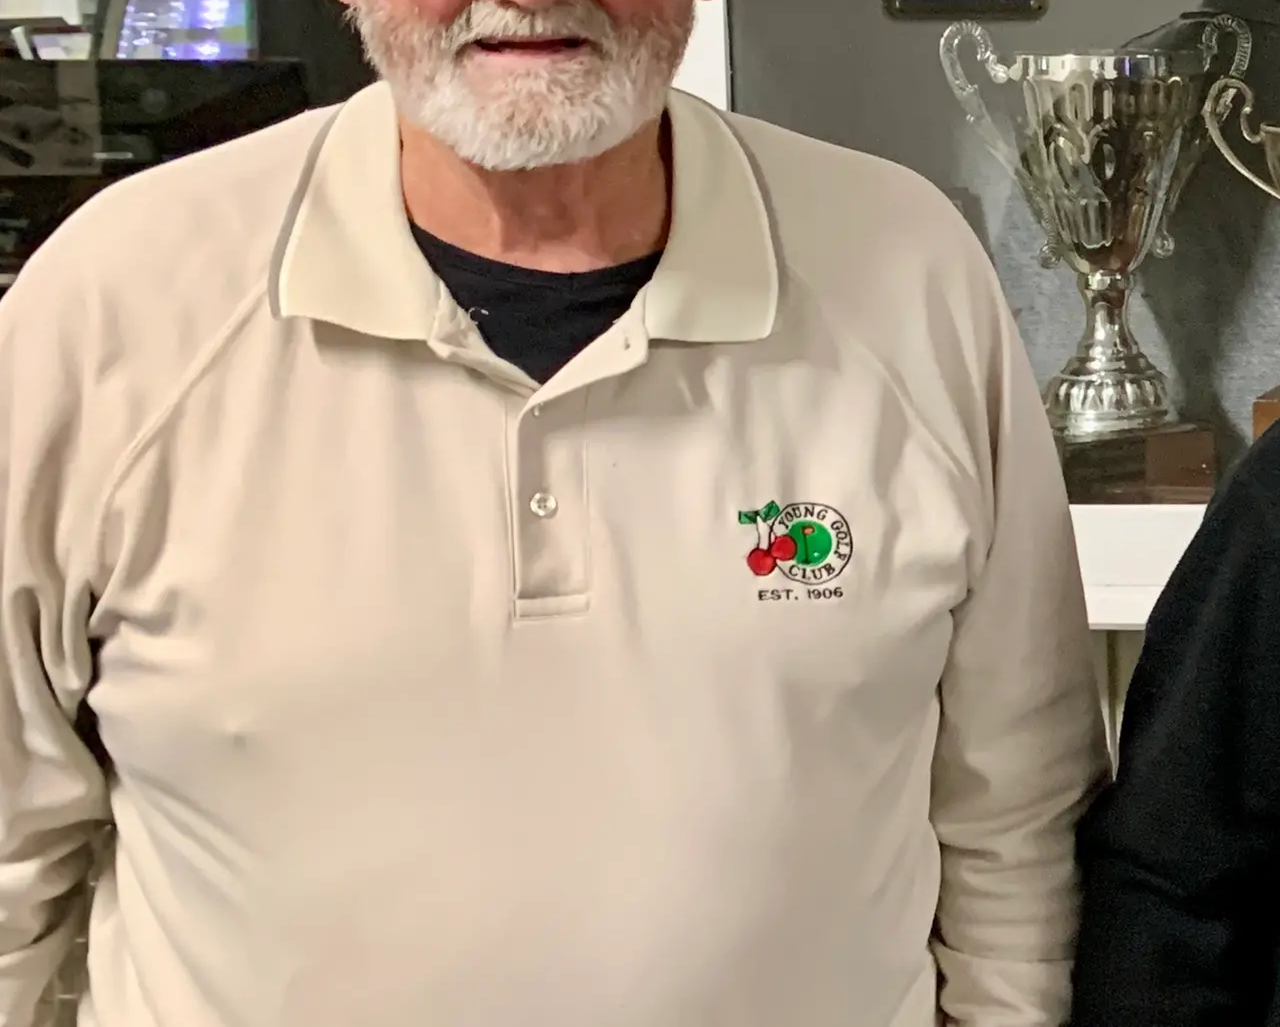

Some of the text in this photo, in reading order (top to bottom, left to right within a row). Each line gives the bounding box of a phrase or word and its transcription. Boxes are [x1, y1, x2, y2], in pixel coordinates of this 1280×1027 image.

[778, 505, 850, 562] YOUNG GOLF
[788, 563, 836, 580] CLUB
[757, 587, 844, 601] EST. 1906
